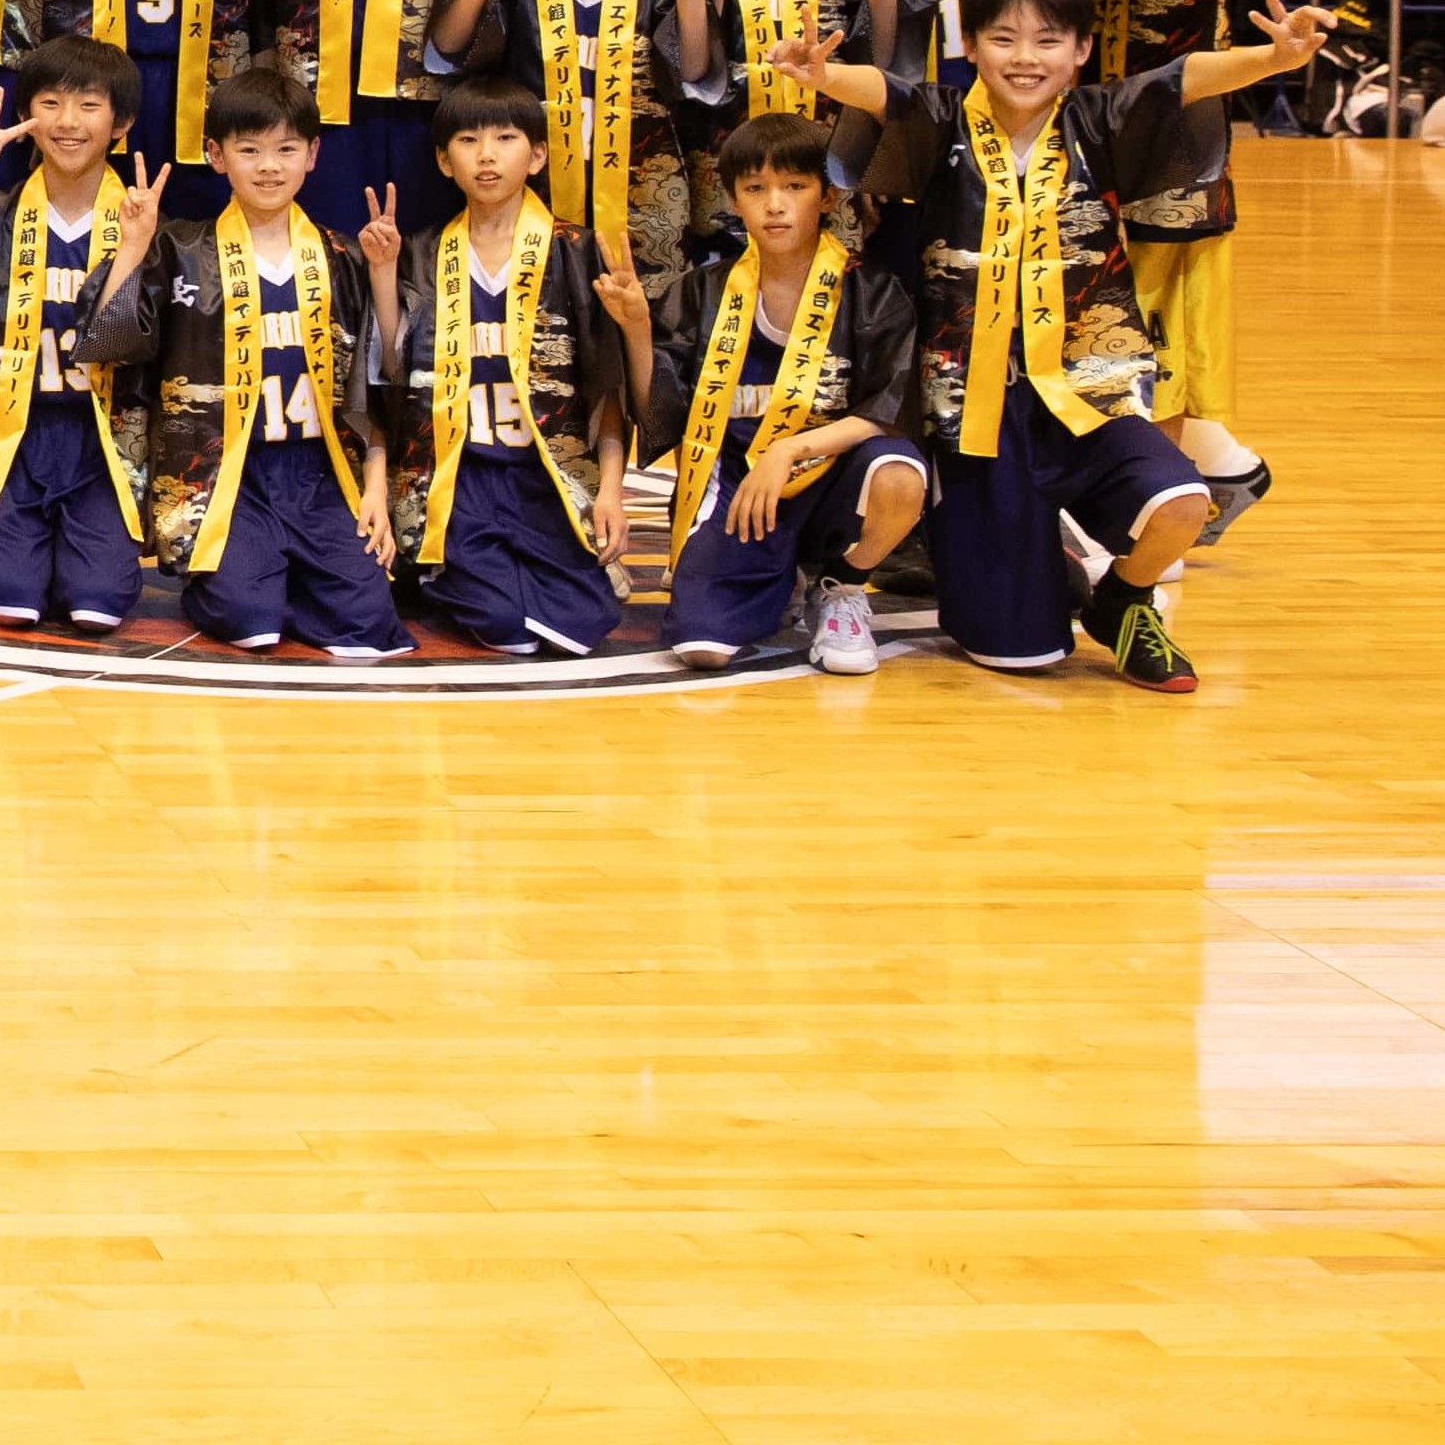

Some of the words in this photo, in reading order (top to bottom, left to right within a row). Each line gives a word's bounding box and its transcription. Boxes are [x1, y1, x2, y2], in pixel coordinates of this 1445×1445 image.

[6, 208, 38, 414] 出前館でデリバリー!
[262, 373, 322, 442] 14
[469, 383, 534, 447] 15
